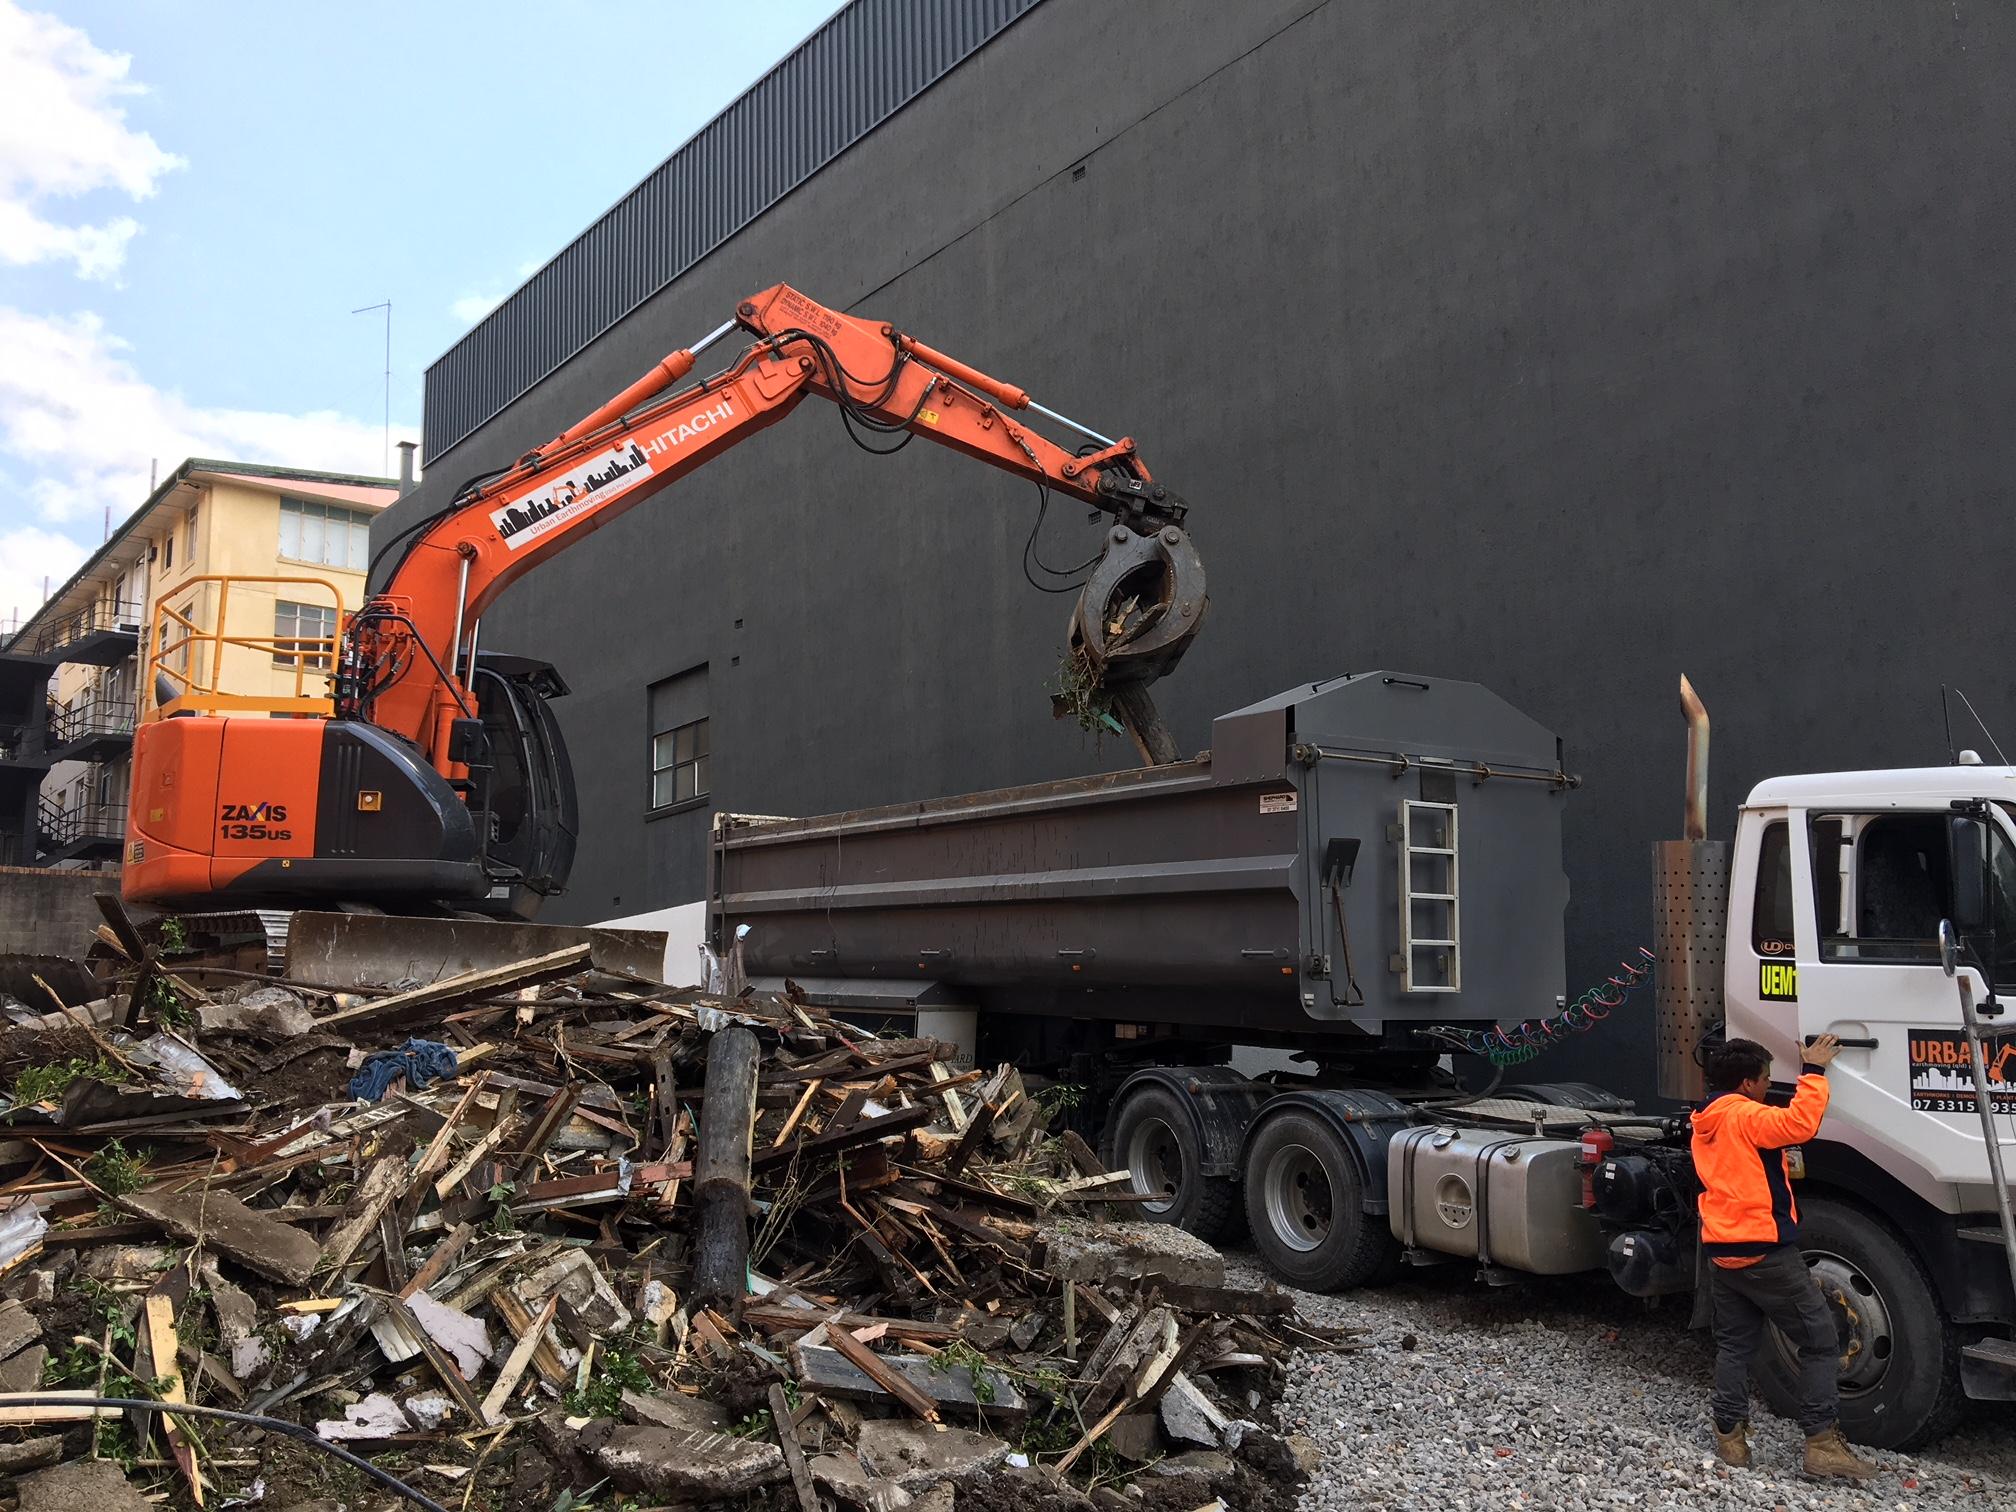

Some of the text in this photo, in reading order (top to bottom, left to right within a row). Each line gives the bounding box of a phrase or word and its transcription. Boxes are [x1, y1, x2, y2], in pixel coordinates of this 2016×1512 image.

[639, 401, 734, 460] HITACHI
[530, 517, 556, 535] Urban
[556, 491, 607, 522] Earthmoving
[221, 801, 287, 823] ZAXIS
[1763, 941, 1781, 951] UD
[1912, 1061, 1951, 1069] earthmoving
[1913, 1099, 2016, 1114] 07 3315 935
